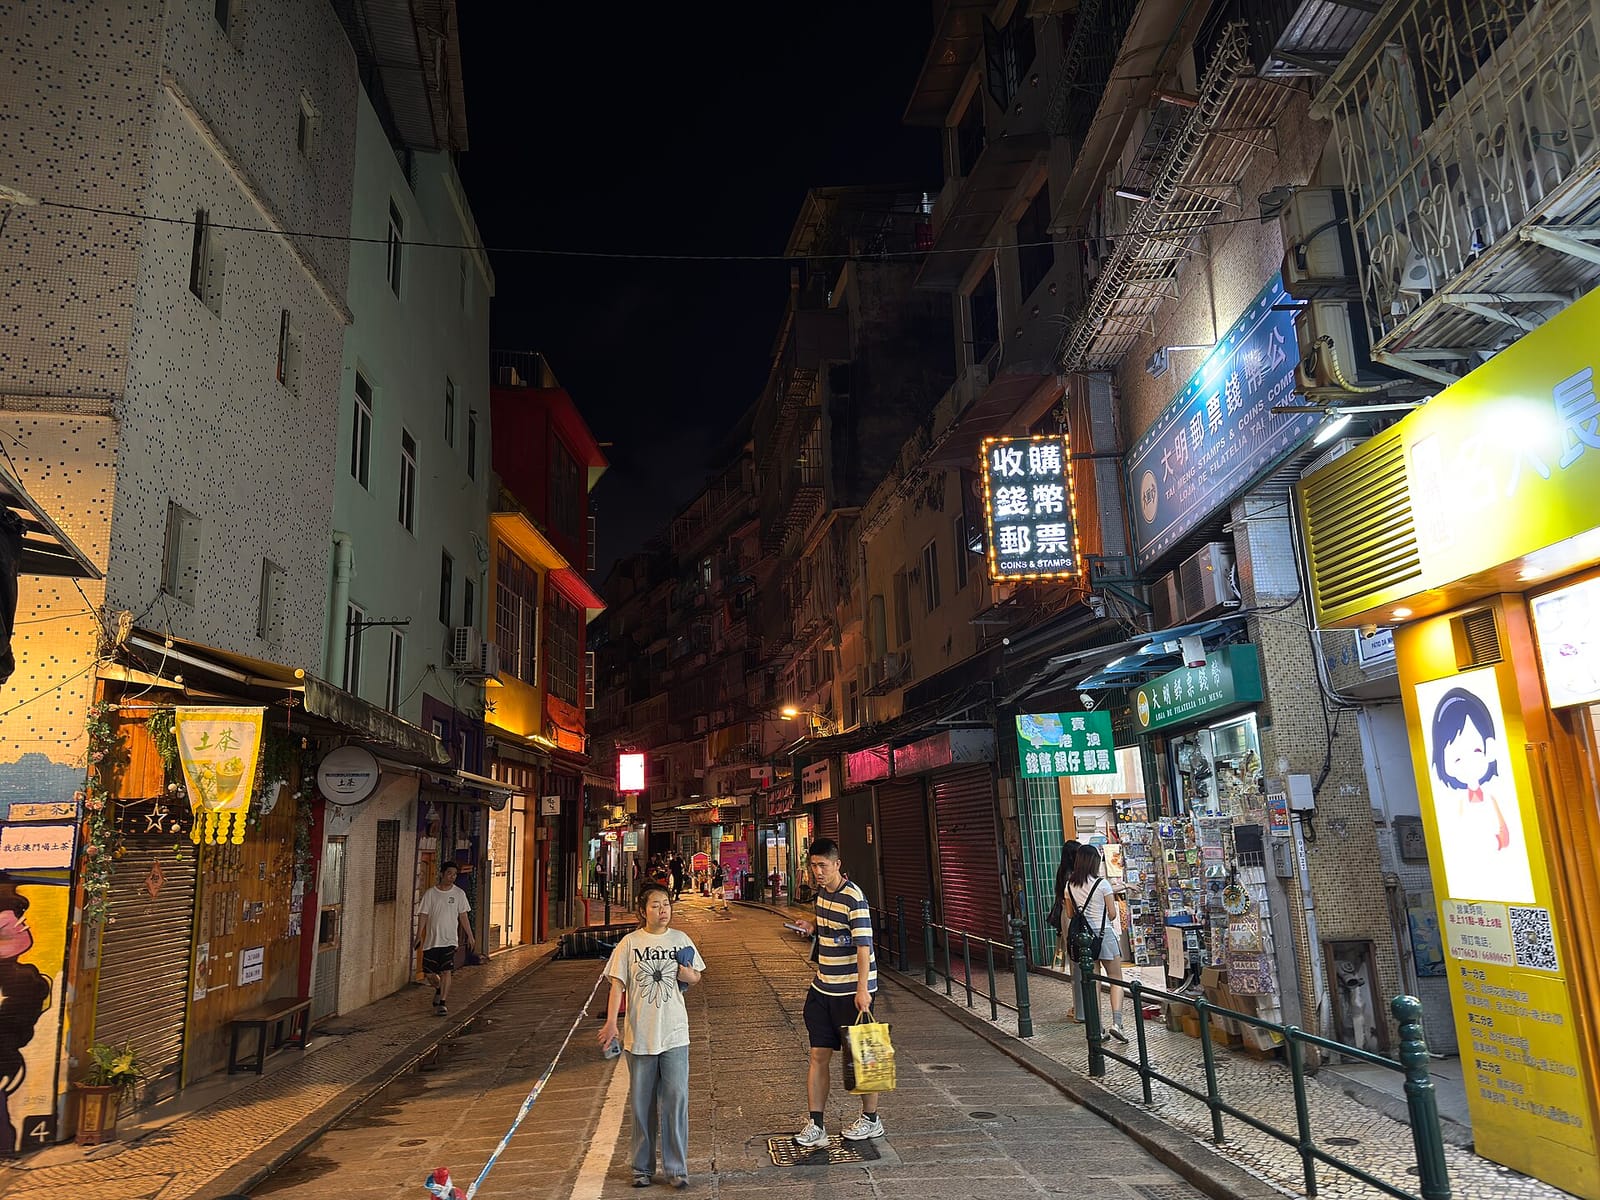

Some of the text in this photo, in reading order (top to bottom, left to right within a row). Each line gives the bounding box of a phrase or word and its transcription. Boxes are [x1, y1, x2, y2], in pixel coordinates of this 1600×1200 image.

[993, 445, 1061, 477] 收購
[1166, 484, 1176, 500] TAI
[1198, 437, 1226, 469] STAMPS
[1229, 428, 1235, 440] &
[1238, 400, 1264, 430] COINS
[1180, 483, 1196, 503] LOJA
[1198, 471, 1208, 486] DE
[1210, 436, 1248, 475] FILATELIA
[1250, 417, 1265, 437] TAI
[996, 484, 1064, 516] 錢幣
[1000, 523, 1068, 555] 郵票
[1000, 559, 1072, 570] COINS & STAMPS
[1198, 696, 1207, 706] TAI
[1208, 690, 1223, 703] MENG
[193, 727, 240, 752] 土茶
[3, 842, 70, 852] 我在澳門喝土茶
[633, 946, 682, 963] Mard
[29, 1120, 50, 1143] 4
